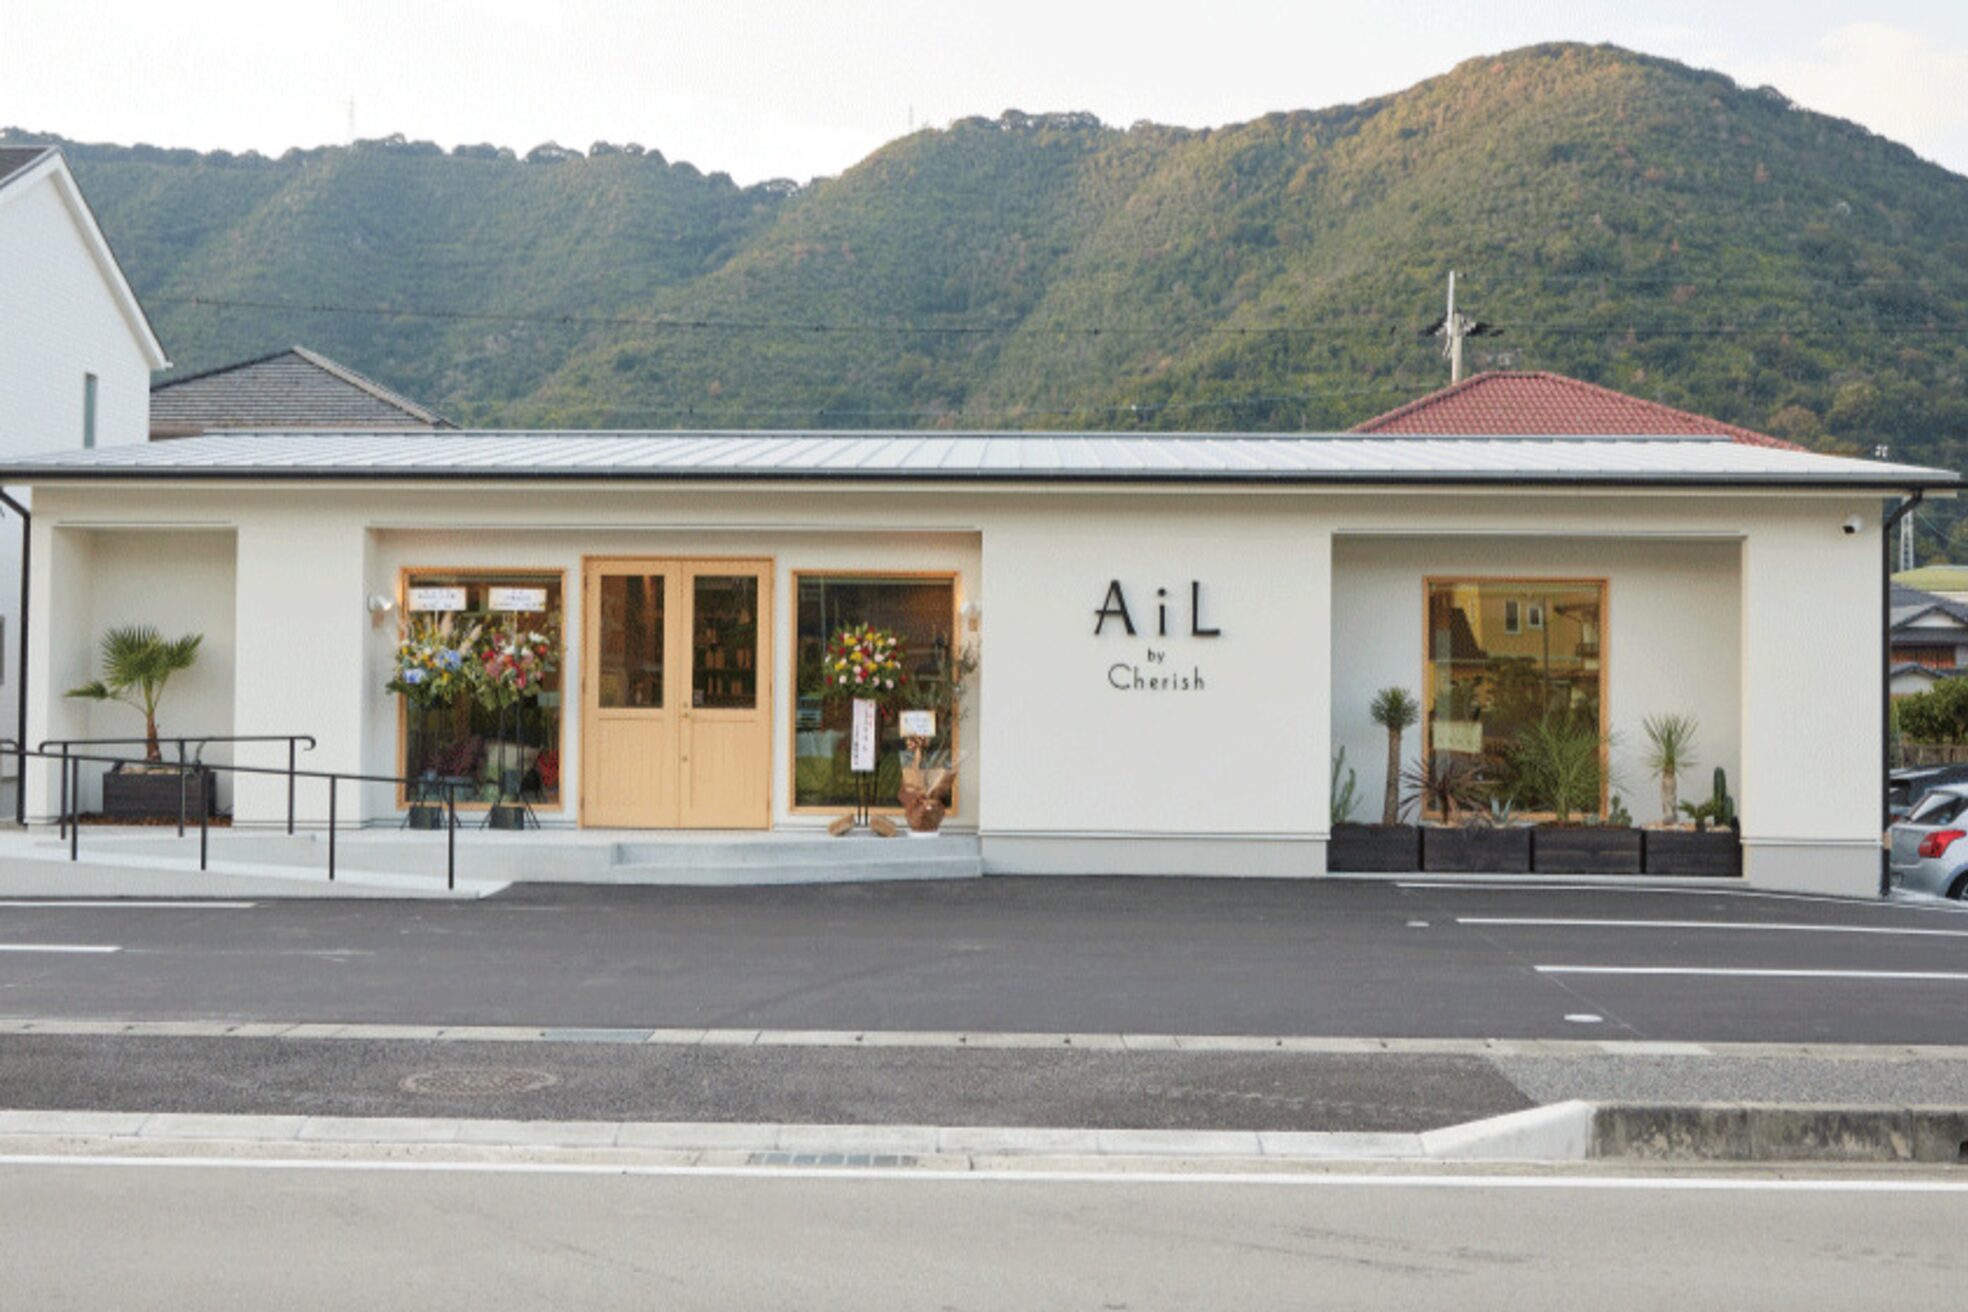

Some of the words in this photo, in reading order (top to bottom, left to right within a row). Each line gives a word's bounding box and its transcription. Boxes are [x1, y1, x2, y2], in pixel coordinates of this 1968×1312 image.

[1094, 579, 1221, 637] AiL
[1147, 648, 1165, 664] by
[1107, 663, 1205, 690] Cherish
